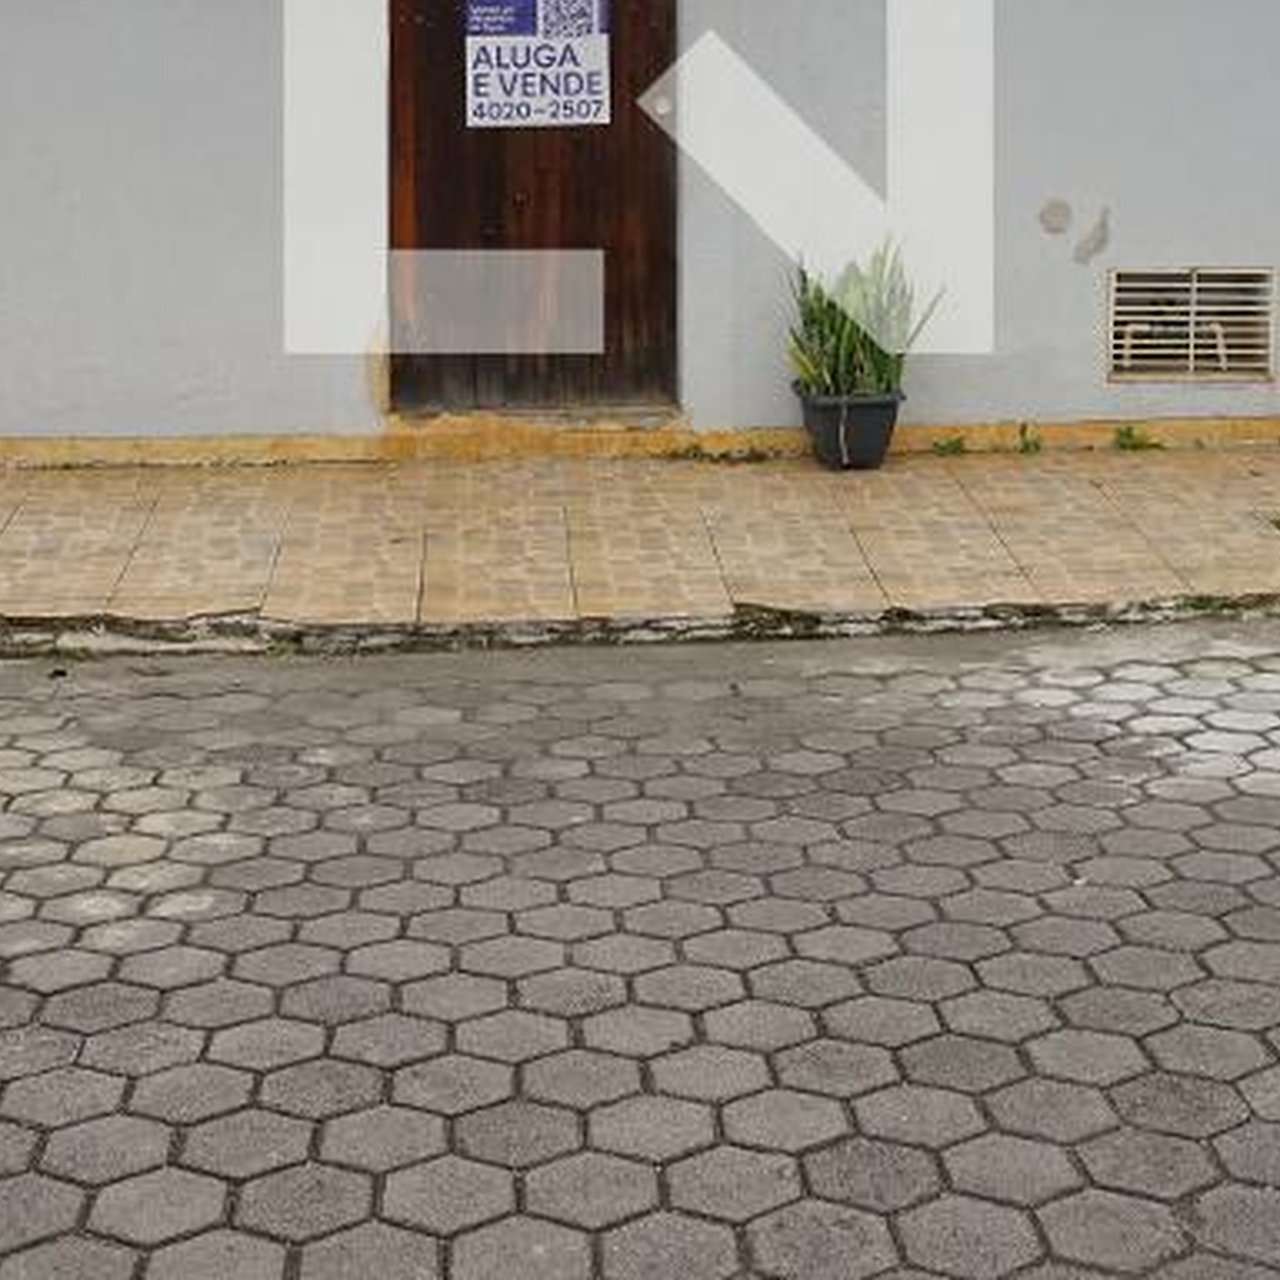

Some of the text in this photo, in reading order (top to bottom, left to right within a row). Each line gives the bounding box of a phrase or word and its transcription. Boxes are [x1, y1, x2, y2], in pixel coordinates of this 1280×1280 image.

[472, 44, 581, 69] ALUGA
[473, 71, 603, 98] E VENDE
[472, 99, 603, 120] 4020-2507
